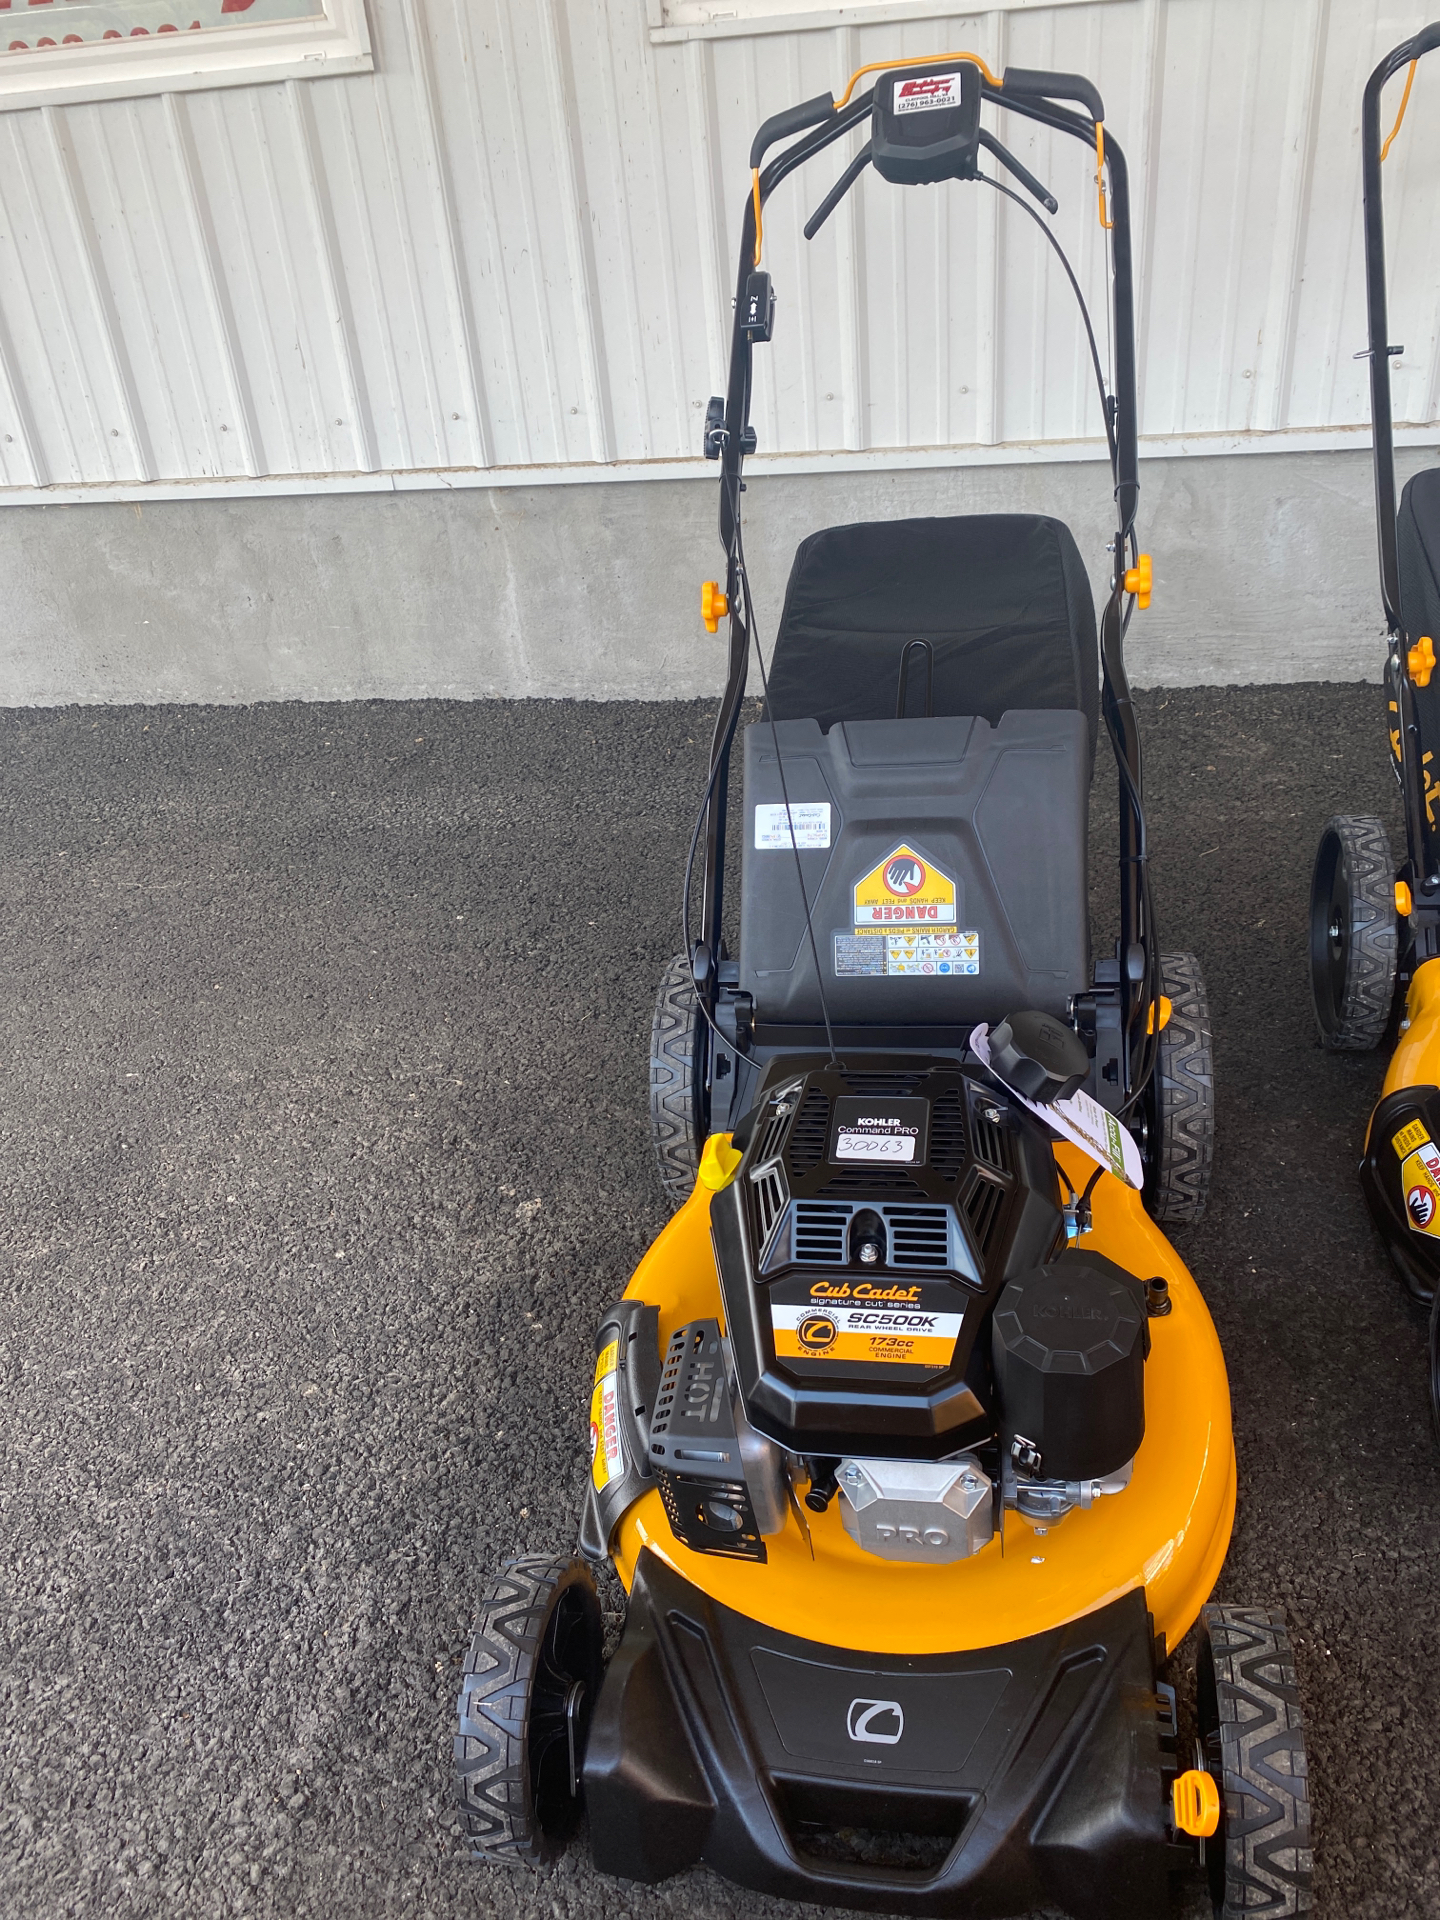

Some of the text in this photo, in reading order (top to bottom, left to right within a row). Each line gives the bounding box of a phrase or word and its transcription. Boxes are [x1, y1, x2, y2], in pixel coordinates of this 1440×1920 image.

[898, 96, 954, 109] (276) 963-0021
[872, 906, 938, 920] DANGER
[857, 1118, 901, 1126] KOHLER
[838, 1126, 919, 1135] Command PRO
[1412, 1124, 1426, 1141] GARDER
[838, 1138, 903, 1154] 30063
[1415, 1159, 1426, 1170] KEEP
[1424, 1172, 1434, 1188] HANDS
[810, 1281, 922, 1302] Cub Cadet
[810, 1297, 862, 1306] signature
[887, 1302, 921, 1310] series
[796, 1308, 842, 1324] COMMERCIAL
[847, 1312, 940, 1328] SC500K
[1033, 1304, 1102, 1320] KOHLER
[869, 1336, 914, 1348] 173cc
[797, 1346, 836, 1357] ENGINE
[682, 1362, 714, 1422] HOT
[604, 1391, 618, 1460] DANGER
[875, 1524, 950, 1548] PRO
